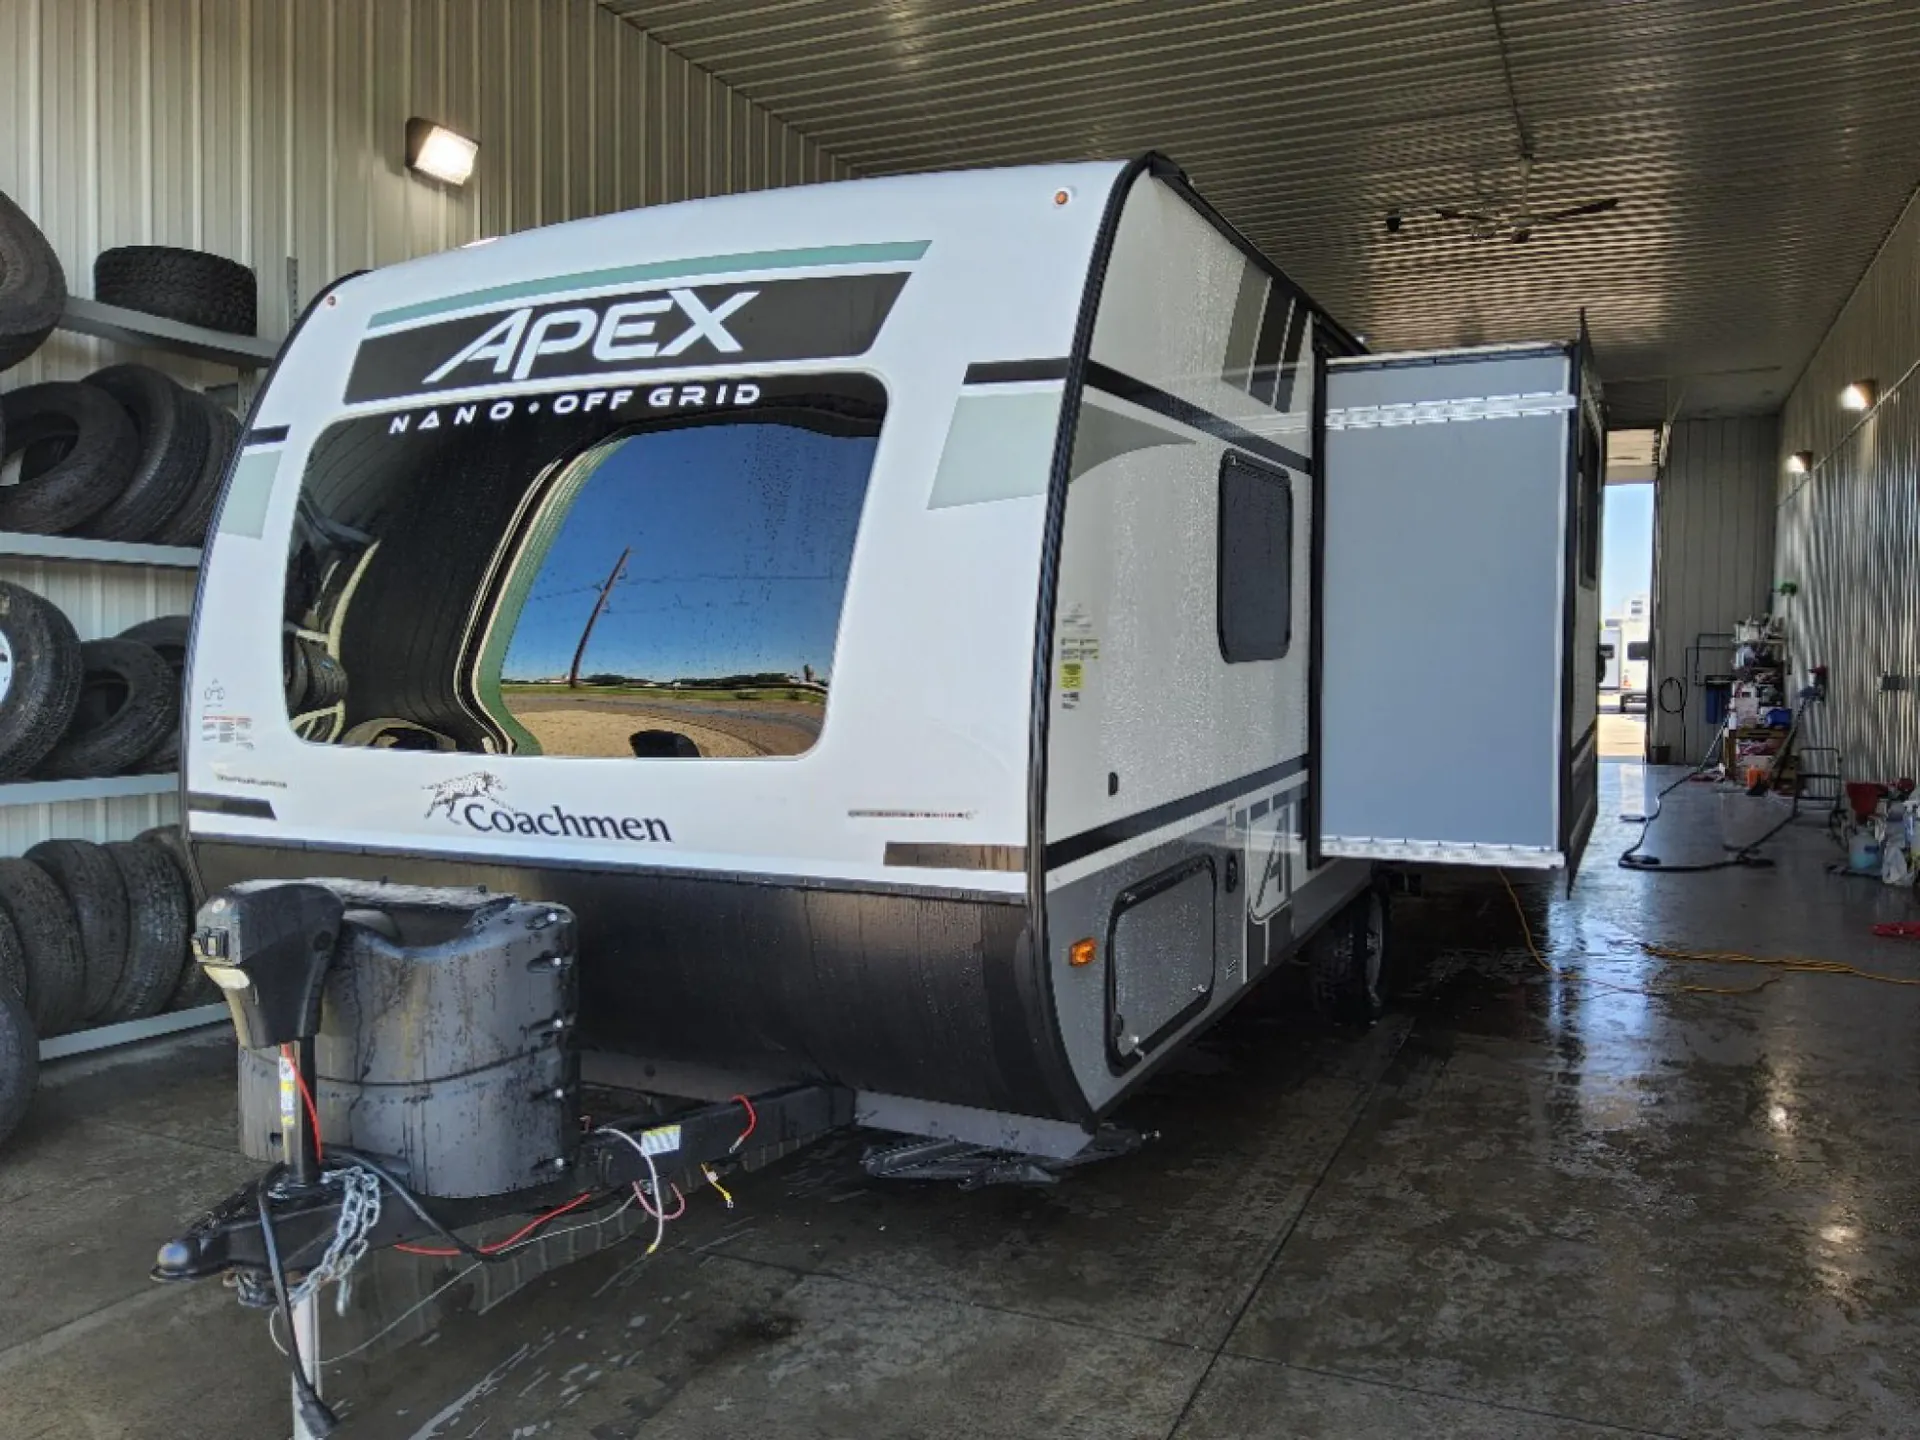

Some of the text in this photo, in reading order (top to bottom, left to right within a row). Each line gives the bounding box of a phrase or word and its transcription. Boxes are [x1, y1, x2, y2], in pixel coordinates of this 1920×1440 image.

[421, 288, 760, 384] APEX
[388, 383, 761, 435] NANO OFF GRID
[464, 803, 674, 843] Coachmen
